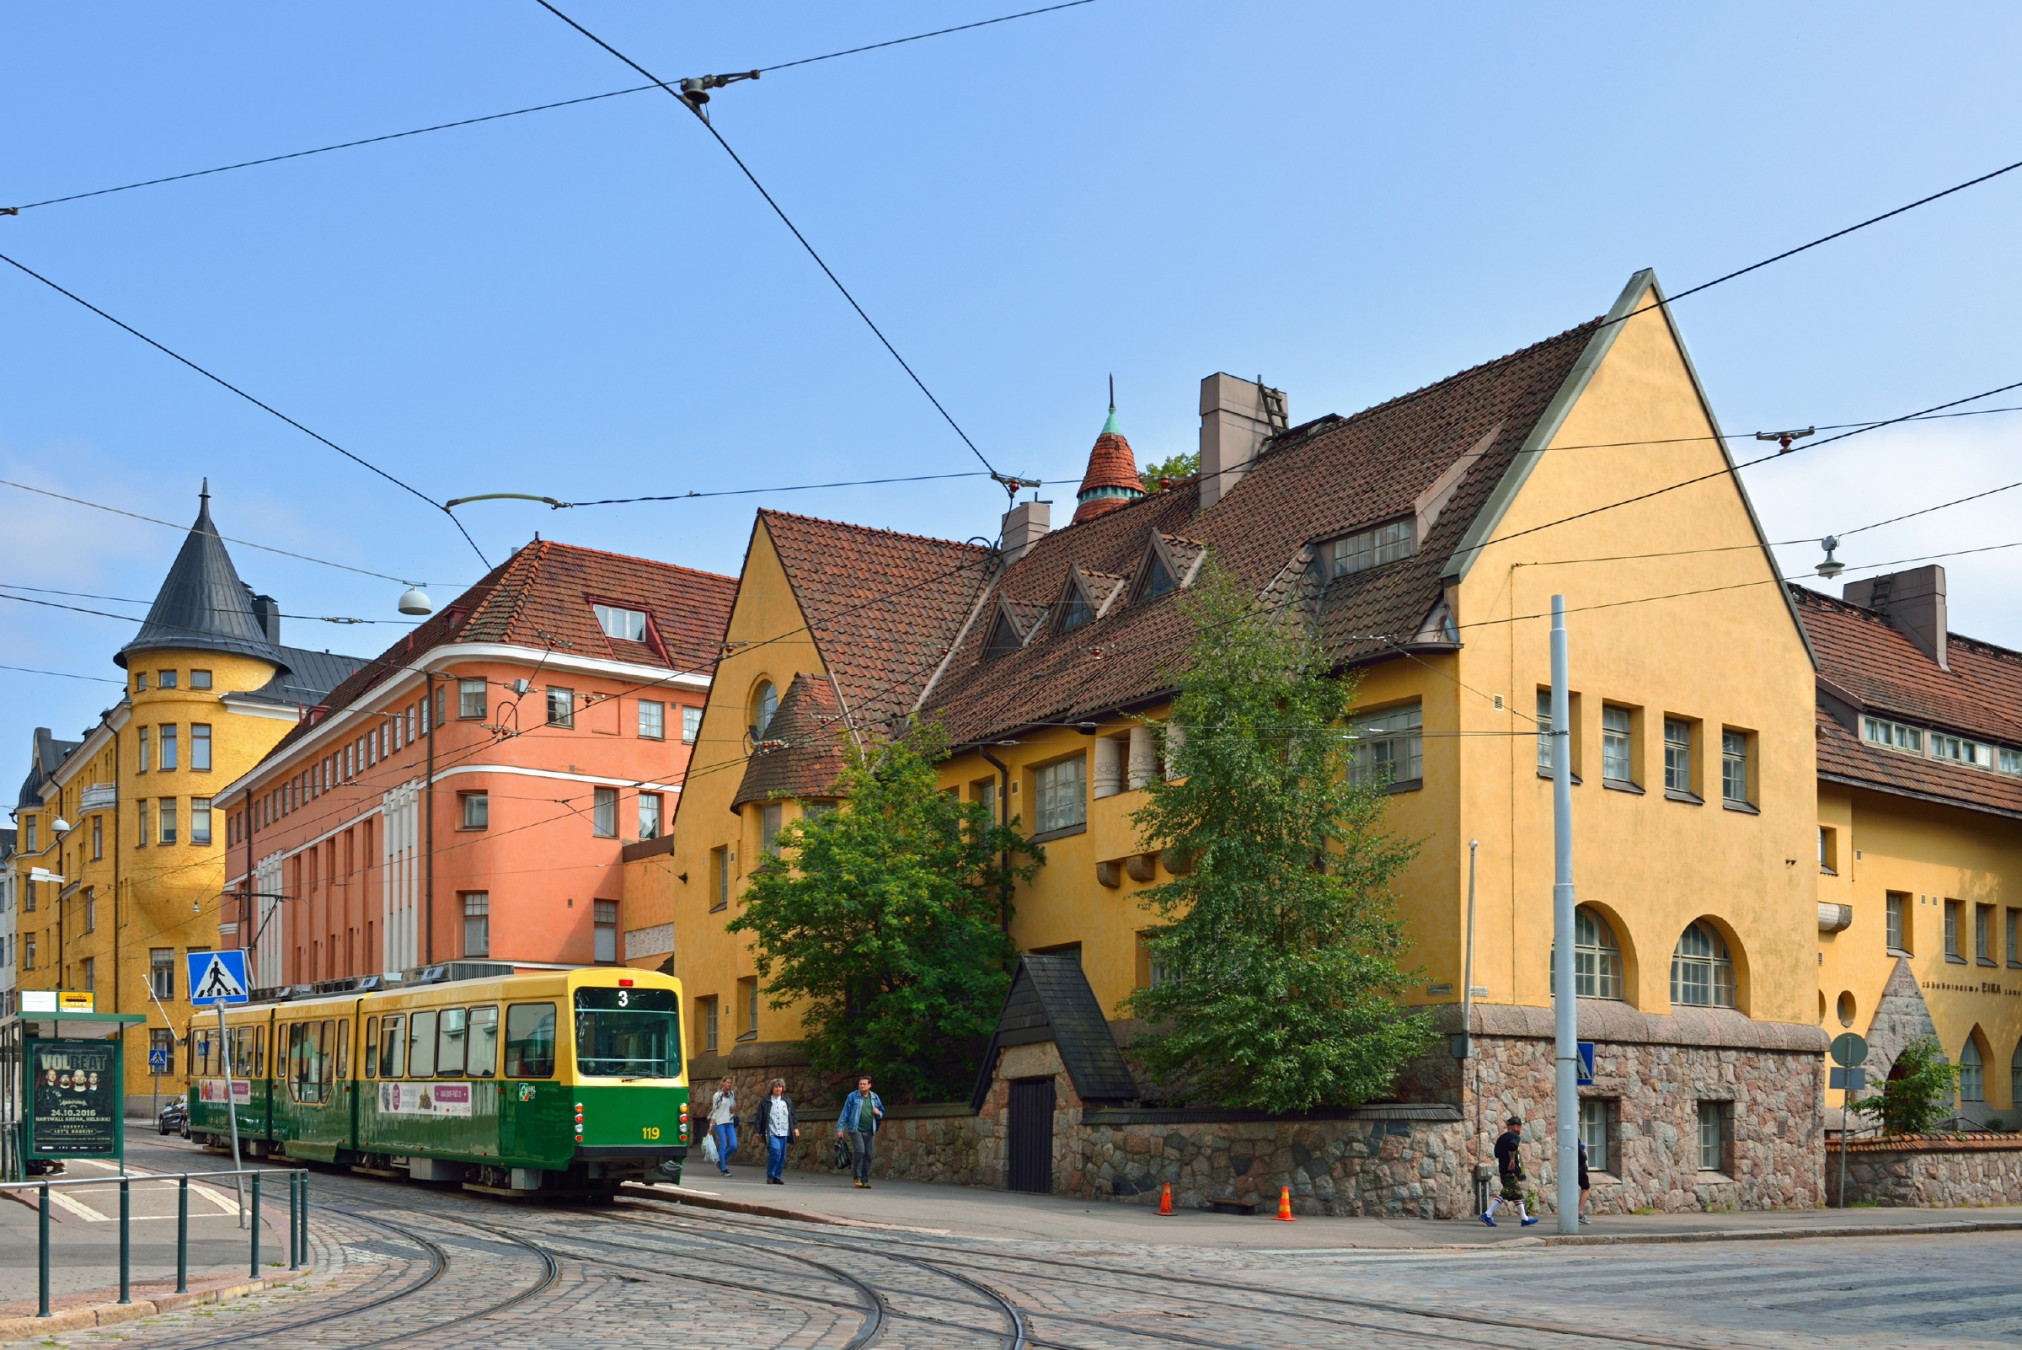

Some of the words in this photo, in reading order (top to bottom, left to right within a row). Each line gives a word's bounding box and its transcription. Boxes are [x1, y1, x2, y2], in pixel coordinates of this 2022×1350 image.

[618, 990, 629, 1007] 3
[40, 1053, 107, 1071] VOLBEAT
[50, 1109, 96, 1117] 24.10.2016
[642, 1126, 660, 1140] 119
